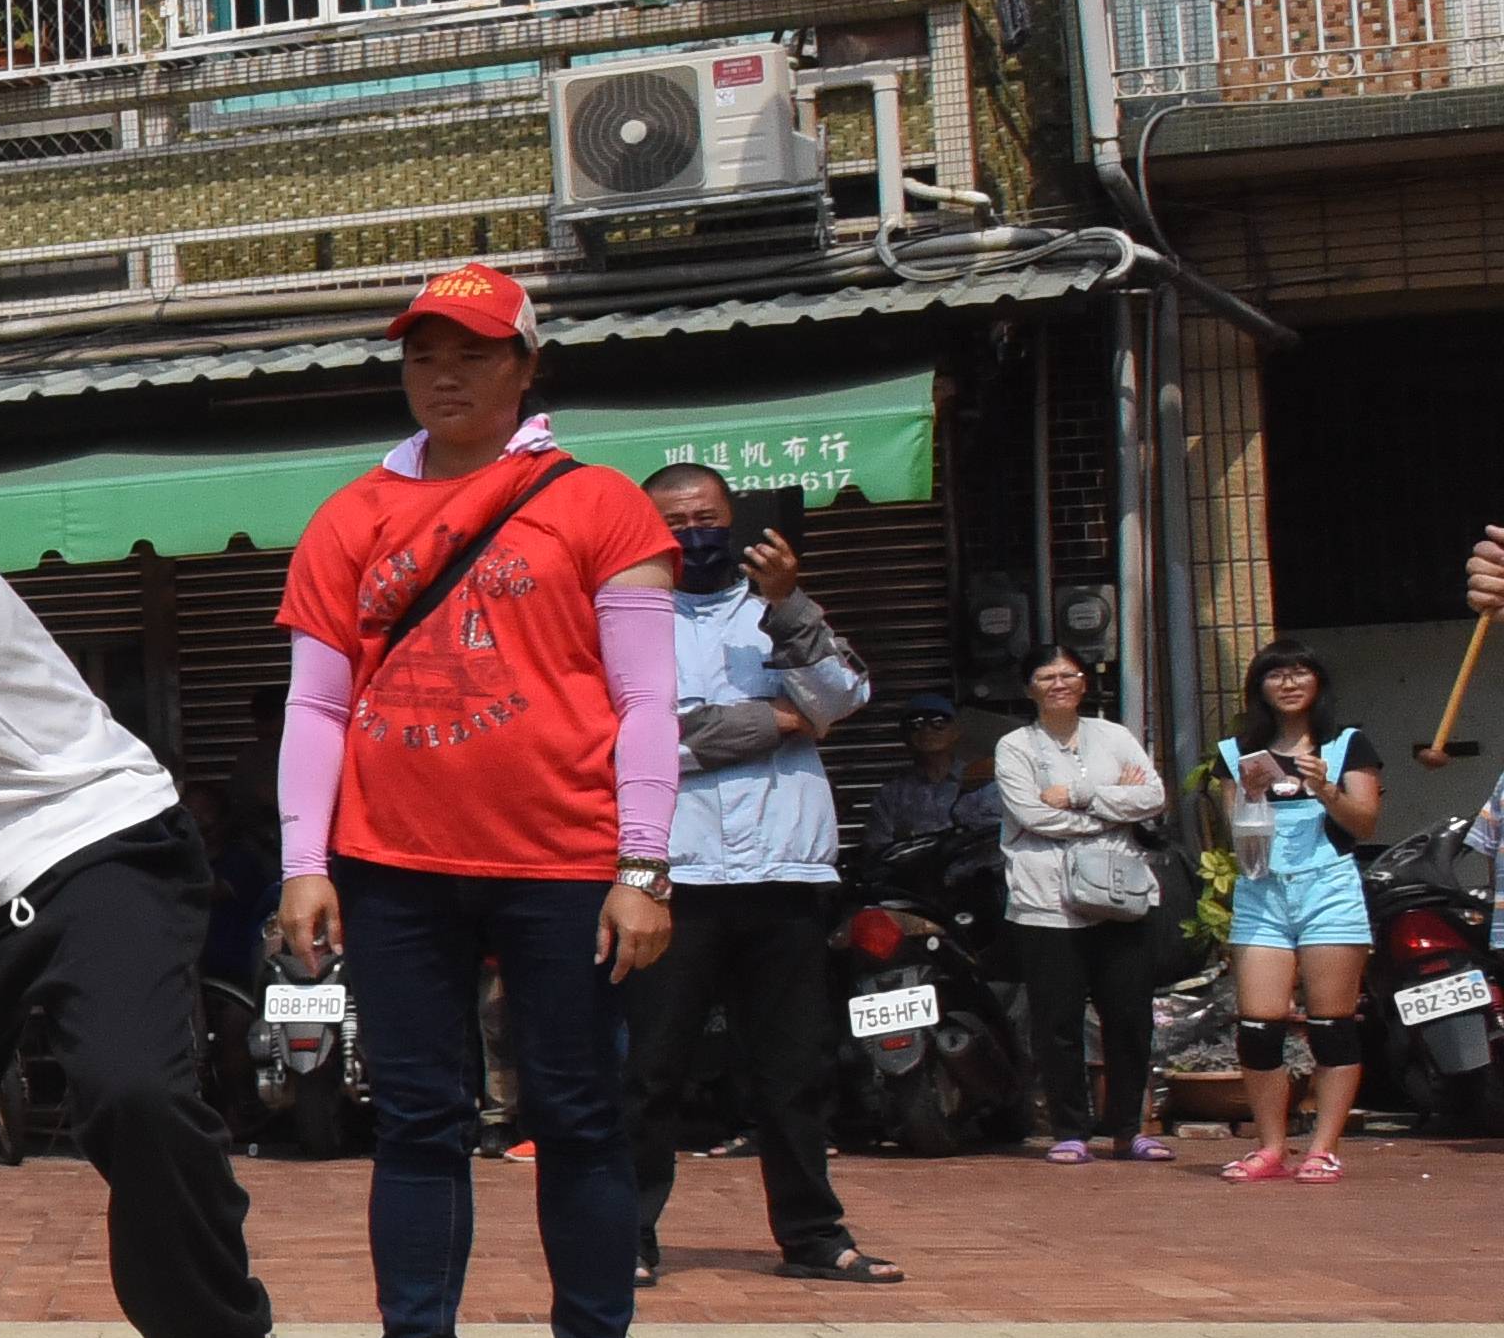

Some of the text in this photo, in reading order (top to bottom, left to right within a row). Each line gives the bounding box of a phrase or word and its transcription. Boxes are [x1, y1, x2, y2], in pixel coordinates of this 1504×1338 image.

[268, 997, 341, 1015] 088-PHD
[853, 998, 932, 1030] 758-HFV
[1400, 982, 1487, 1021] P8Z-356
